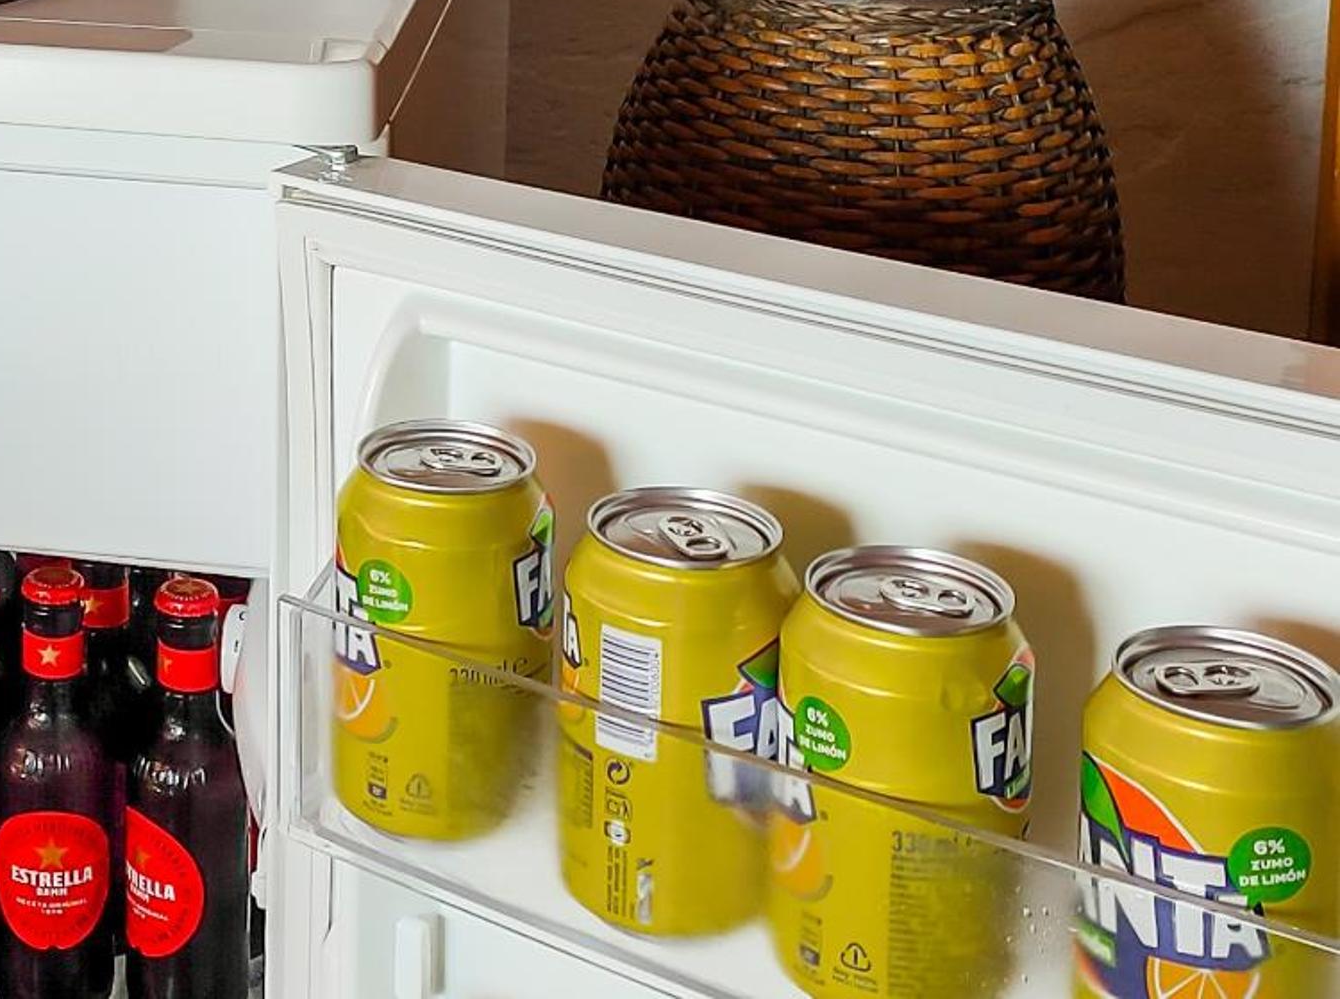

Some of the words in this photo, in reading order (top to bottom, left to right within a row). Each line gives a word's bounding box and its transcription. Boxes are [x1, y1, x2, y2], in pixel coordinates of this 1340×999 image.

[806, 706, 829, 728] 6%
[804, 723, 836, 744] ZUMO
[812, 742, 847, 761] LIMÓN
[1253, 838, 1286, 856] 6%
[1250, 857, 1295, 872] ZUMO
[11, 863, 94, 888] ESTRELLA
[126, 860, 177, 902] TRELLA
[1079, 811, 1264, 959] ANTA
[1238, 875, 1260, 887] DE
[1261, 866, 1308, 887] LIMÓN
[35, 887, 69, 897] DAMM
